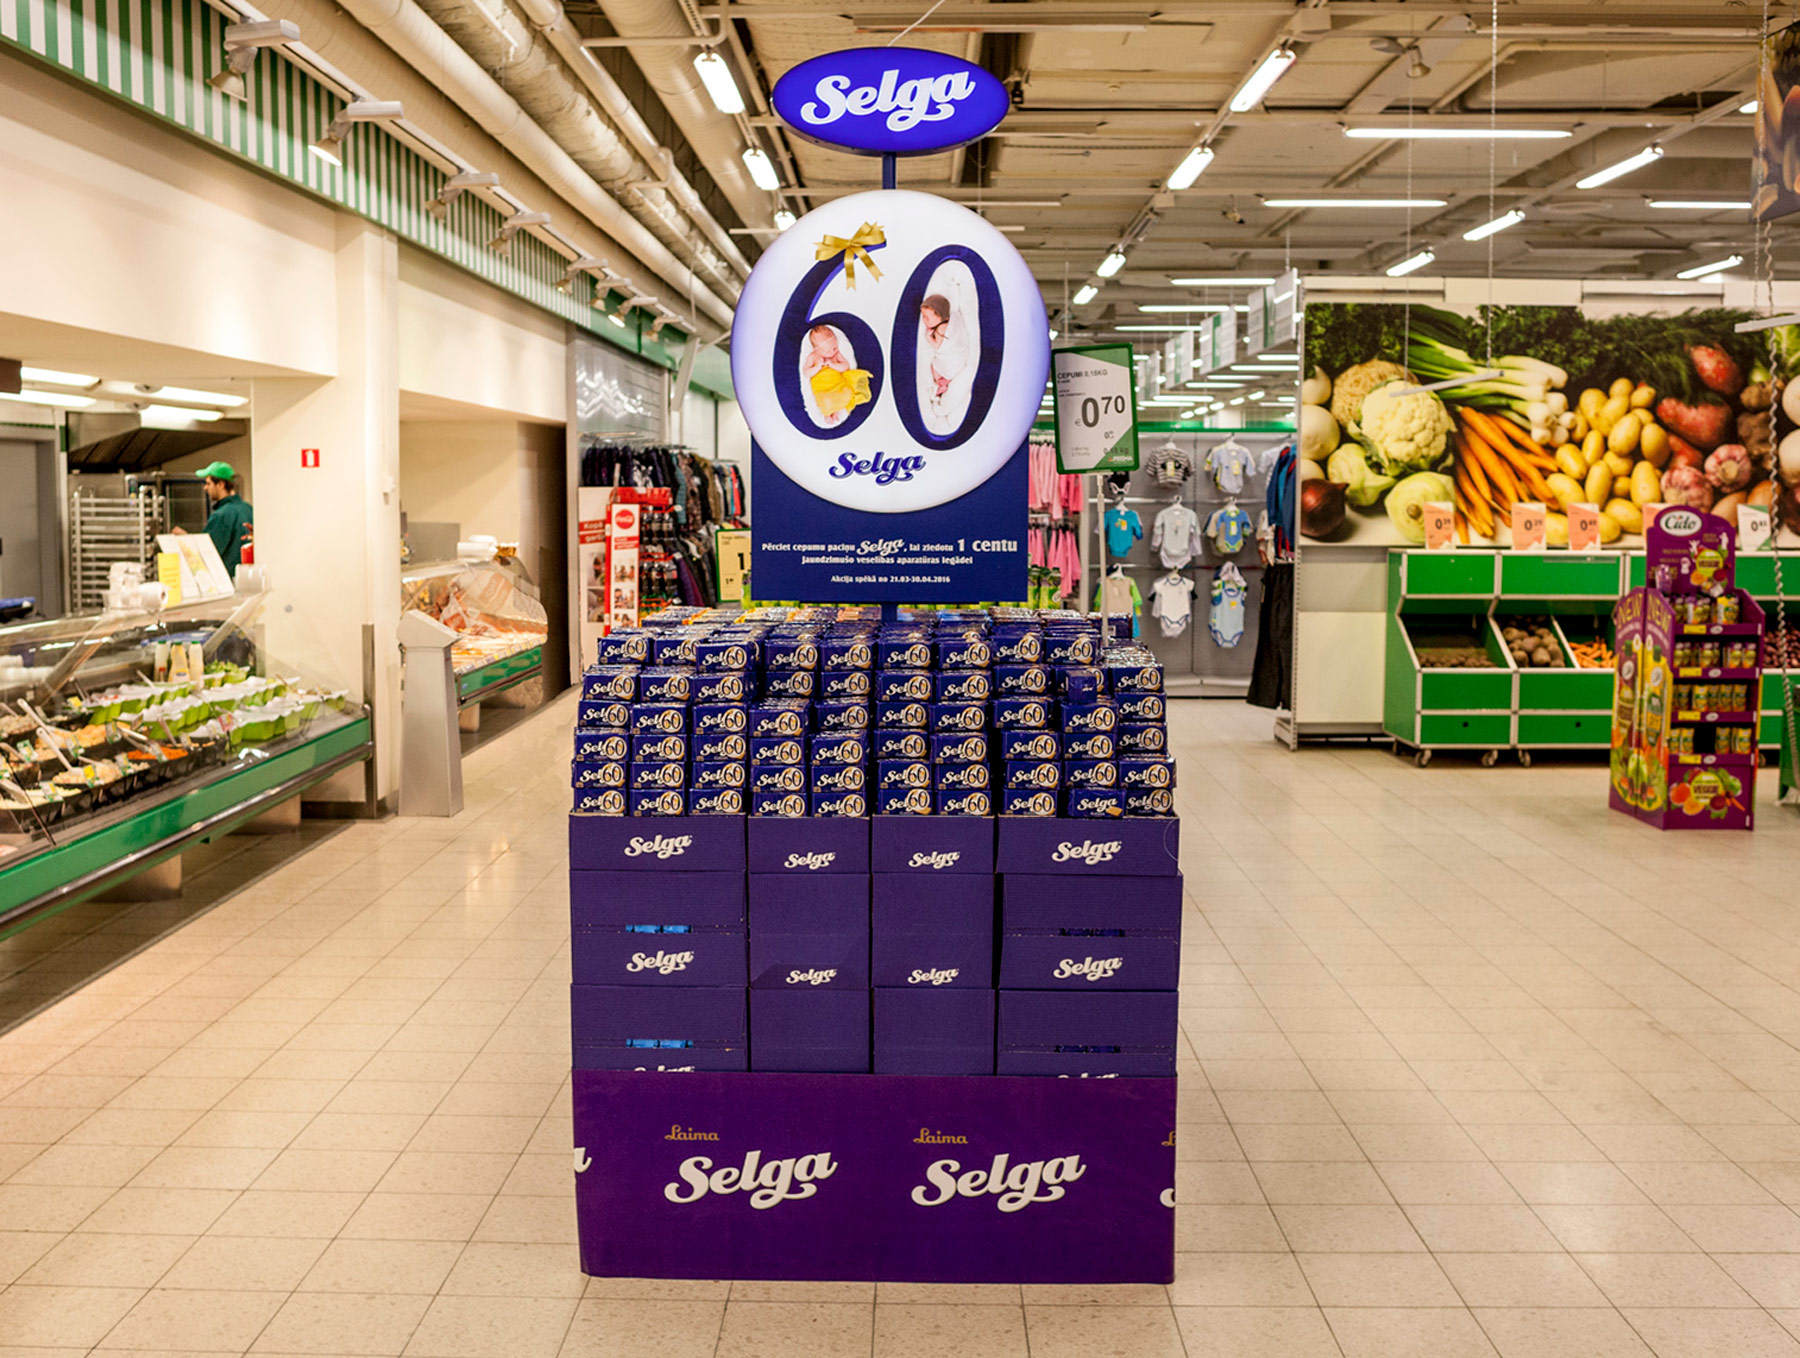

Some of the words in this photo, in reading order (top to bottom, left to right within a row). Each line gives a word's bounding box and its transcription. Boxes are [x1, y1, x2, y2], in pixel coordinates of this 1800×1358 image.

[800, 69, 976, 132] Selga
[772, 238, 1005, 451] 60
[829, 452, 926, 486] Selga
[792, 544, 826, 552] cepumu
[922, 543, 954, 552] ziedotu
[958, 538, 965, 552] 1
[972, 539, 1018, 552] centu
[830, 575, 854, 584] Akcija
[1077, 798, 1118, 812] Selga
[624, 834, 692, 859] Selga
[1052, 840, 1122, 864] Selga
[784, 852, 836, 870] Selga
[908, 851, 960, 870] Selga
[626, 950, 694, 974] Selga
[1054, 956, 1123, 982] Selga
[786, 968, 837, 986] Selga
[908, 968, 959, 986] Selga
[664, 1124, 720, 1141] Laima
[913, 1128, 968, 1144] Laima
[664, 1150, 838, 1210] Selga
[911, 1154, 1087, 1212] Selga
